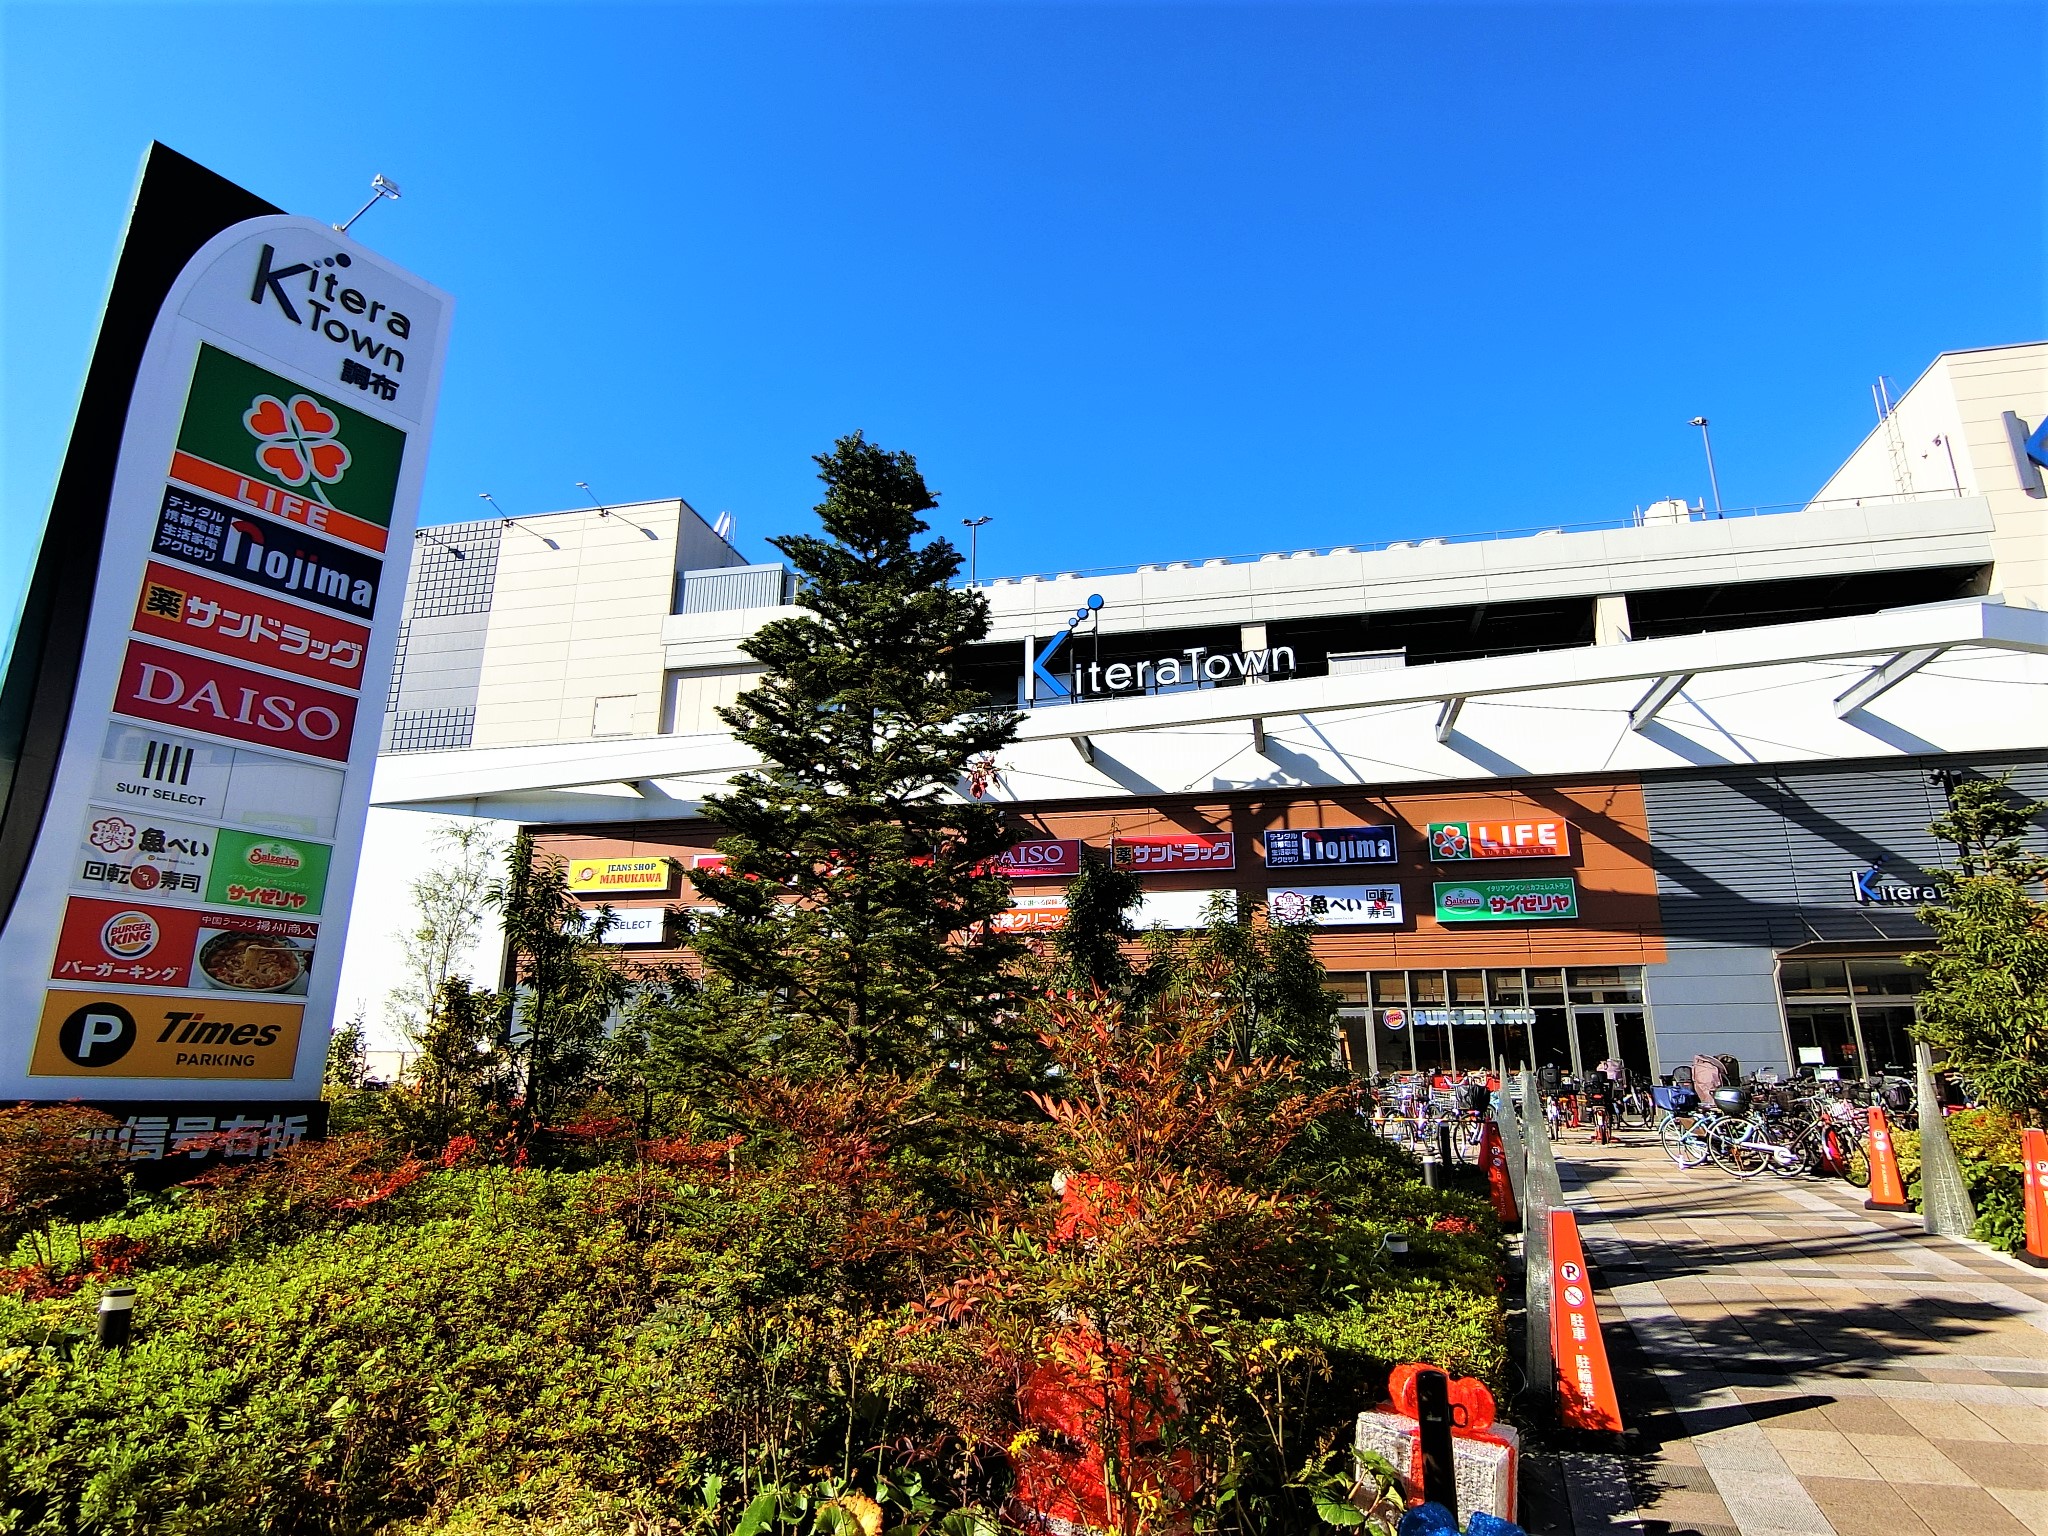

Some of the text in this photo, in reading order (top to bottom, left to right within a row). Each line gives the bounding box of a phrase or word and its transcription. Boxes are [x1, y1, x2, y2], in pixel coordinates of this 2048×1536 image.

[251, 243, 411, 340] Kitera
[308, 299, 405, 373] Town
[340, 357, 400, 401] 調布
[236, 478, 330, 530] LIFE
[164, 508, 222, 537] 携帯電話
[162, 522, 219, 550] 生活家電
[159, 535, 216, 562] アクセサリ
[222, 516, 374, 608] nojima
[145, 585, 363, 669] 薬 サンドラッグ
[132, 662, 341, 741] DAISO
[116, 782, 206, 806] SUIT SELECT
[138, 827, 210, 857] 魚べい
[1302, 831, 1391, 862] nojima
[1478, 823, 1557, 847] LIFE
[991, 844, 1064, 865] AISO
[1133, 841, 1231, 863] サンドラッグ
[1481, 847, 1558, 856] SUPERMARKET
[83, 860, 132, 885] 回転
[160, 870, 202, 893] 寿司
[600, 872, 662, 885] MARUKAWA
[607, 862, 657, 874] JEANS SHOP
[227, 884, 307, 909] サイゼリヤ
[1310, 894, 1362, 914] 魚べい
[1365, 888, 1394, 902] 回転
[1490, 895, 1569, 913] サイゼリヤ
[1366, 904, 1396, 919] 寿司
[111, 922, 152, 936] BURGER
[202, 915, 317, 936] 中国ラーメン 揚州商人
[613, 920, 653, 930] SELECT
[110, 930, 152, 947] KING
[60, 960, 179, 981] バーガーキング
[78, 1014, 123, 1058] P
[156, 1011, 282, 1047] Times
[176, 1052, 255, 1067] PARKING
